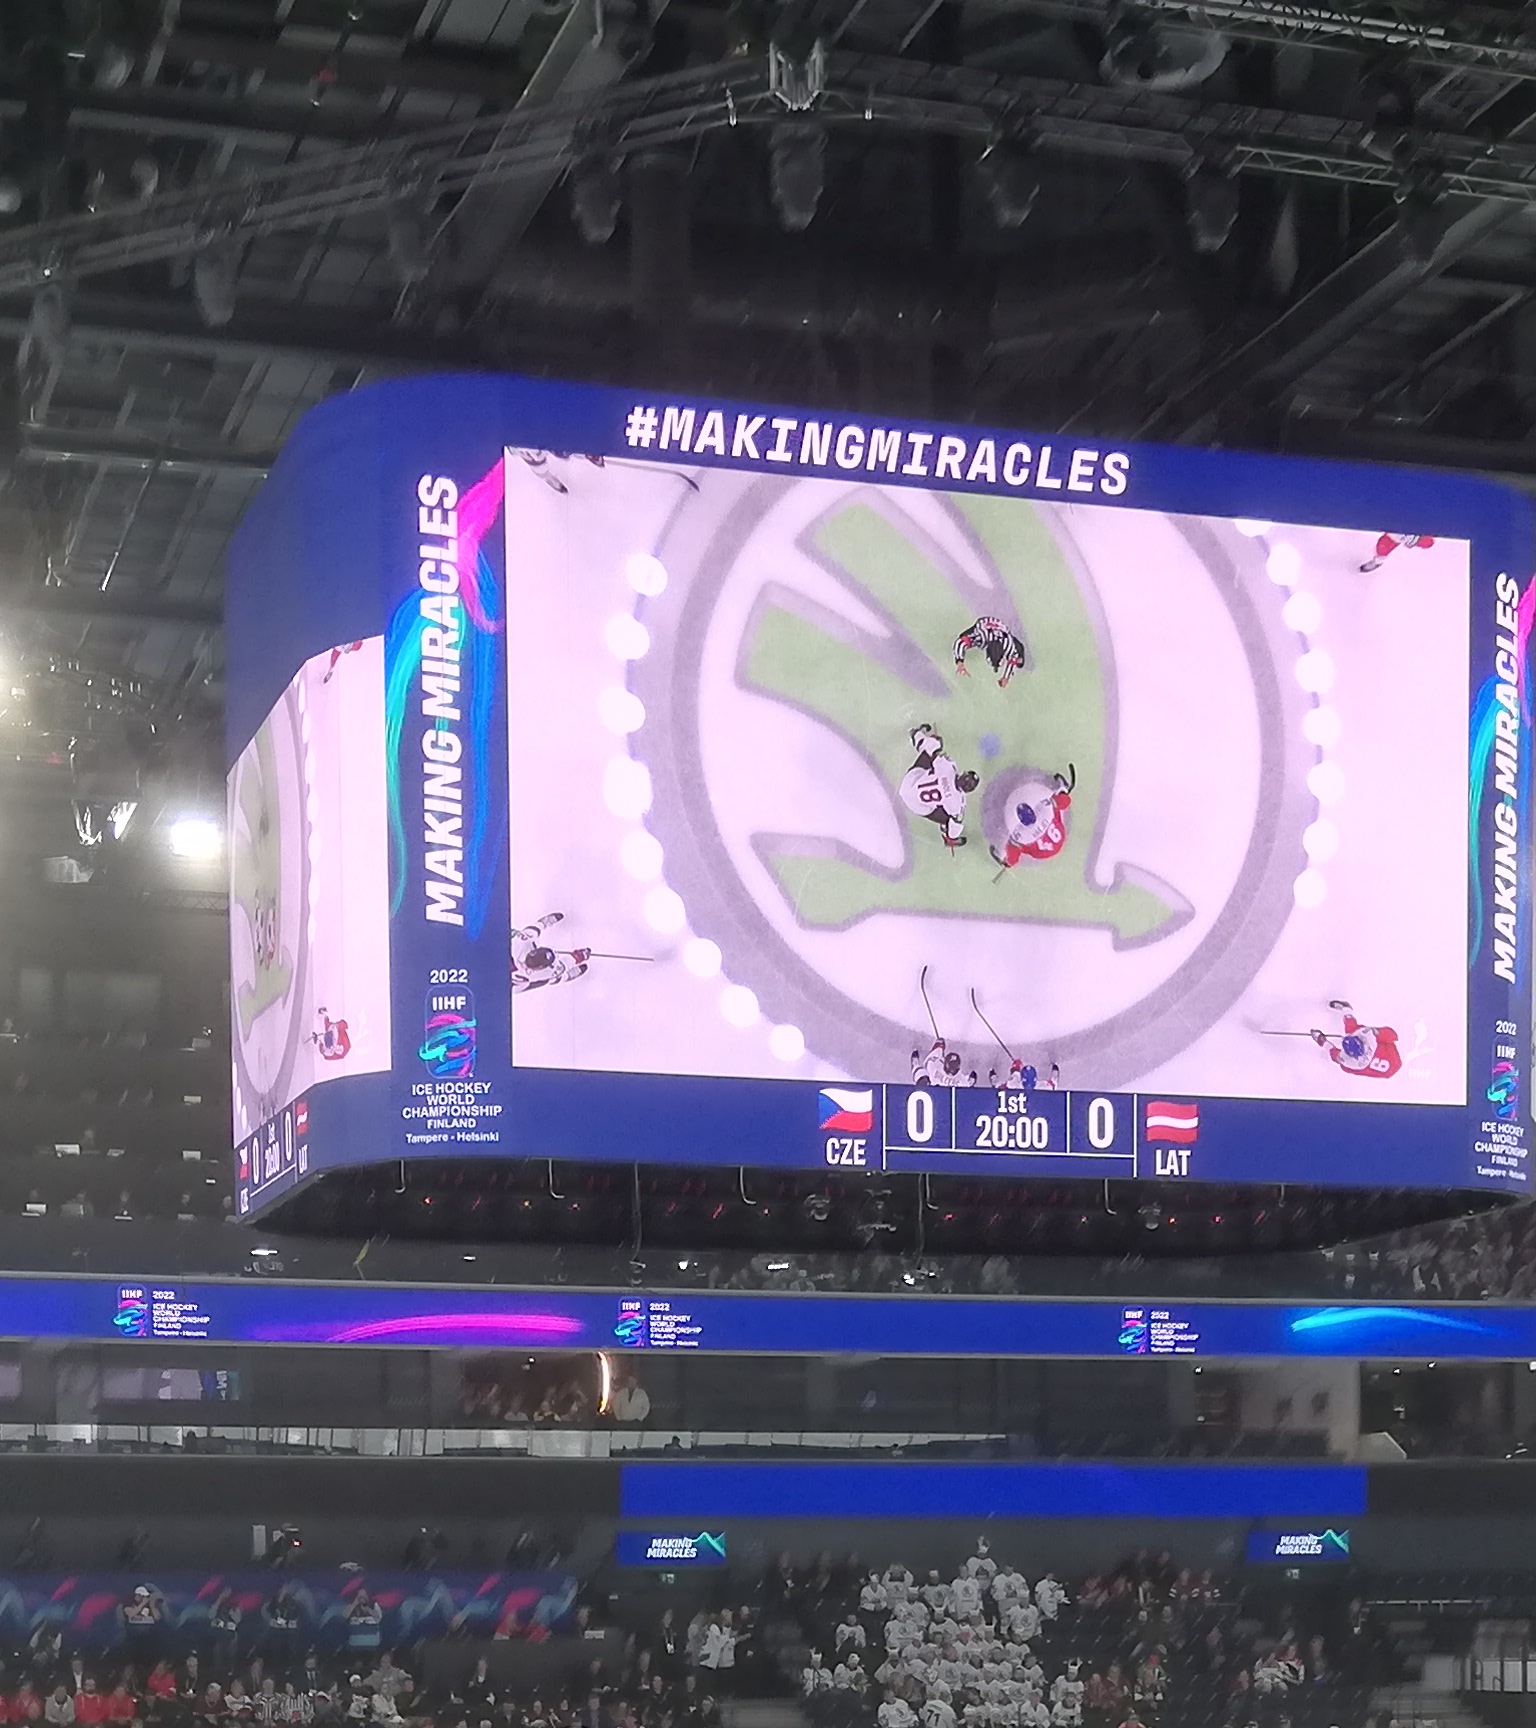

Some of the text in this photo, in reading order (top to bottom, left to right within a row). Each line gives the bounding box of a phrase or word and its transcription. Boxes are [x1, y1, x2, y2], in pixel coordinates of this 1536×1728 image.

[625, 406, 1131, 495] #MAKINGMIRACLES
[417, 474, 464, 926] MAKING MIRACLES
[1492, 573, 1520, 984] MAKING MIRACLES
[430, 969, 468, 983] 2022
[432, 996, 466, 1011] IIHF
[412, 1082, 492, 1095] ICE HOCKEY
[427, 1094, 476, 1106] WORLD
[997, 1090, 1028, 1114] 1st
[402, 1105, 503, 1119] CHAMPIONSHIP
[906, 1091, 934, 1143] 0
[427, 1118, 477, 1129] FINLAND
[1088, 1097, 1115, 1149] 0
[975, 1115, 1049, 1149] 20:00
[826, 1138, 867, 1166] CZE
[1155, 1149, 1192, 1177] LAT
[651, 1538, 693, 1549] MAKING
[1279, 1535, 1318, 1546] MAKING
[646, 1547, 697, 1558] MIRACLES
[1275, 1544, 1322, 1555] MIRACLES
